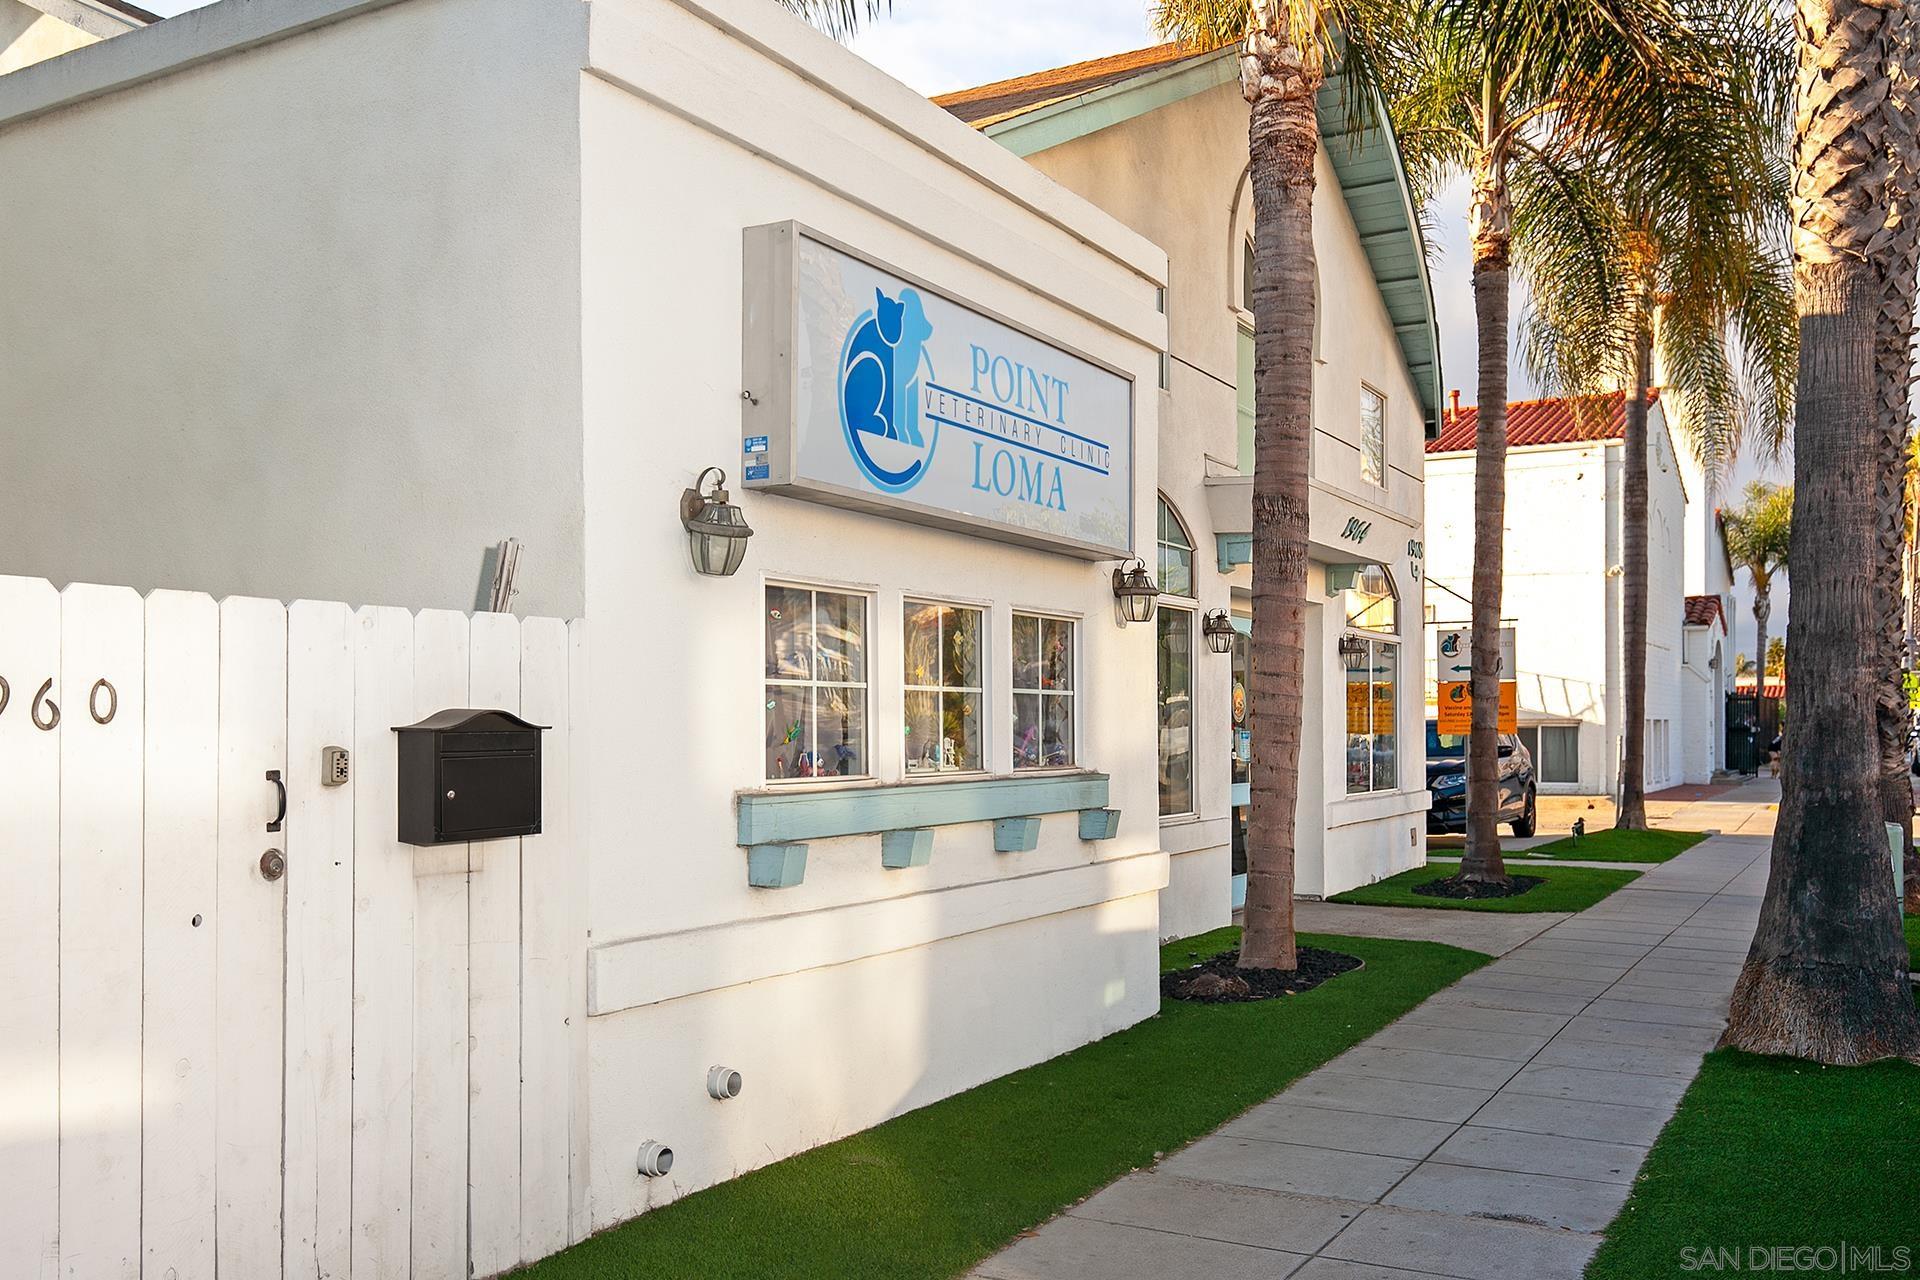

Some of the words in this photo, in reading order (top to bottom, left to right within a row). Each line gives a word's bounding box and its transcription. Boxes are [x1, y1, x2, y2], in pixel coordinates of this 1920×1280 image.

[970, 343, 1070, 424] POINT
[925, 388, 1042, 446] VETERINARY
[1060, 435, 1110, 469] CLINIC
[972, 441, 1067, 512] LOMA
[1340, 516, 1372, 544] 1964
